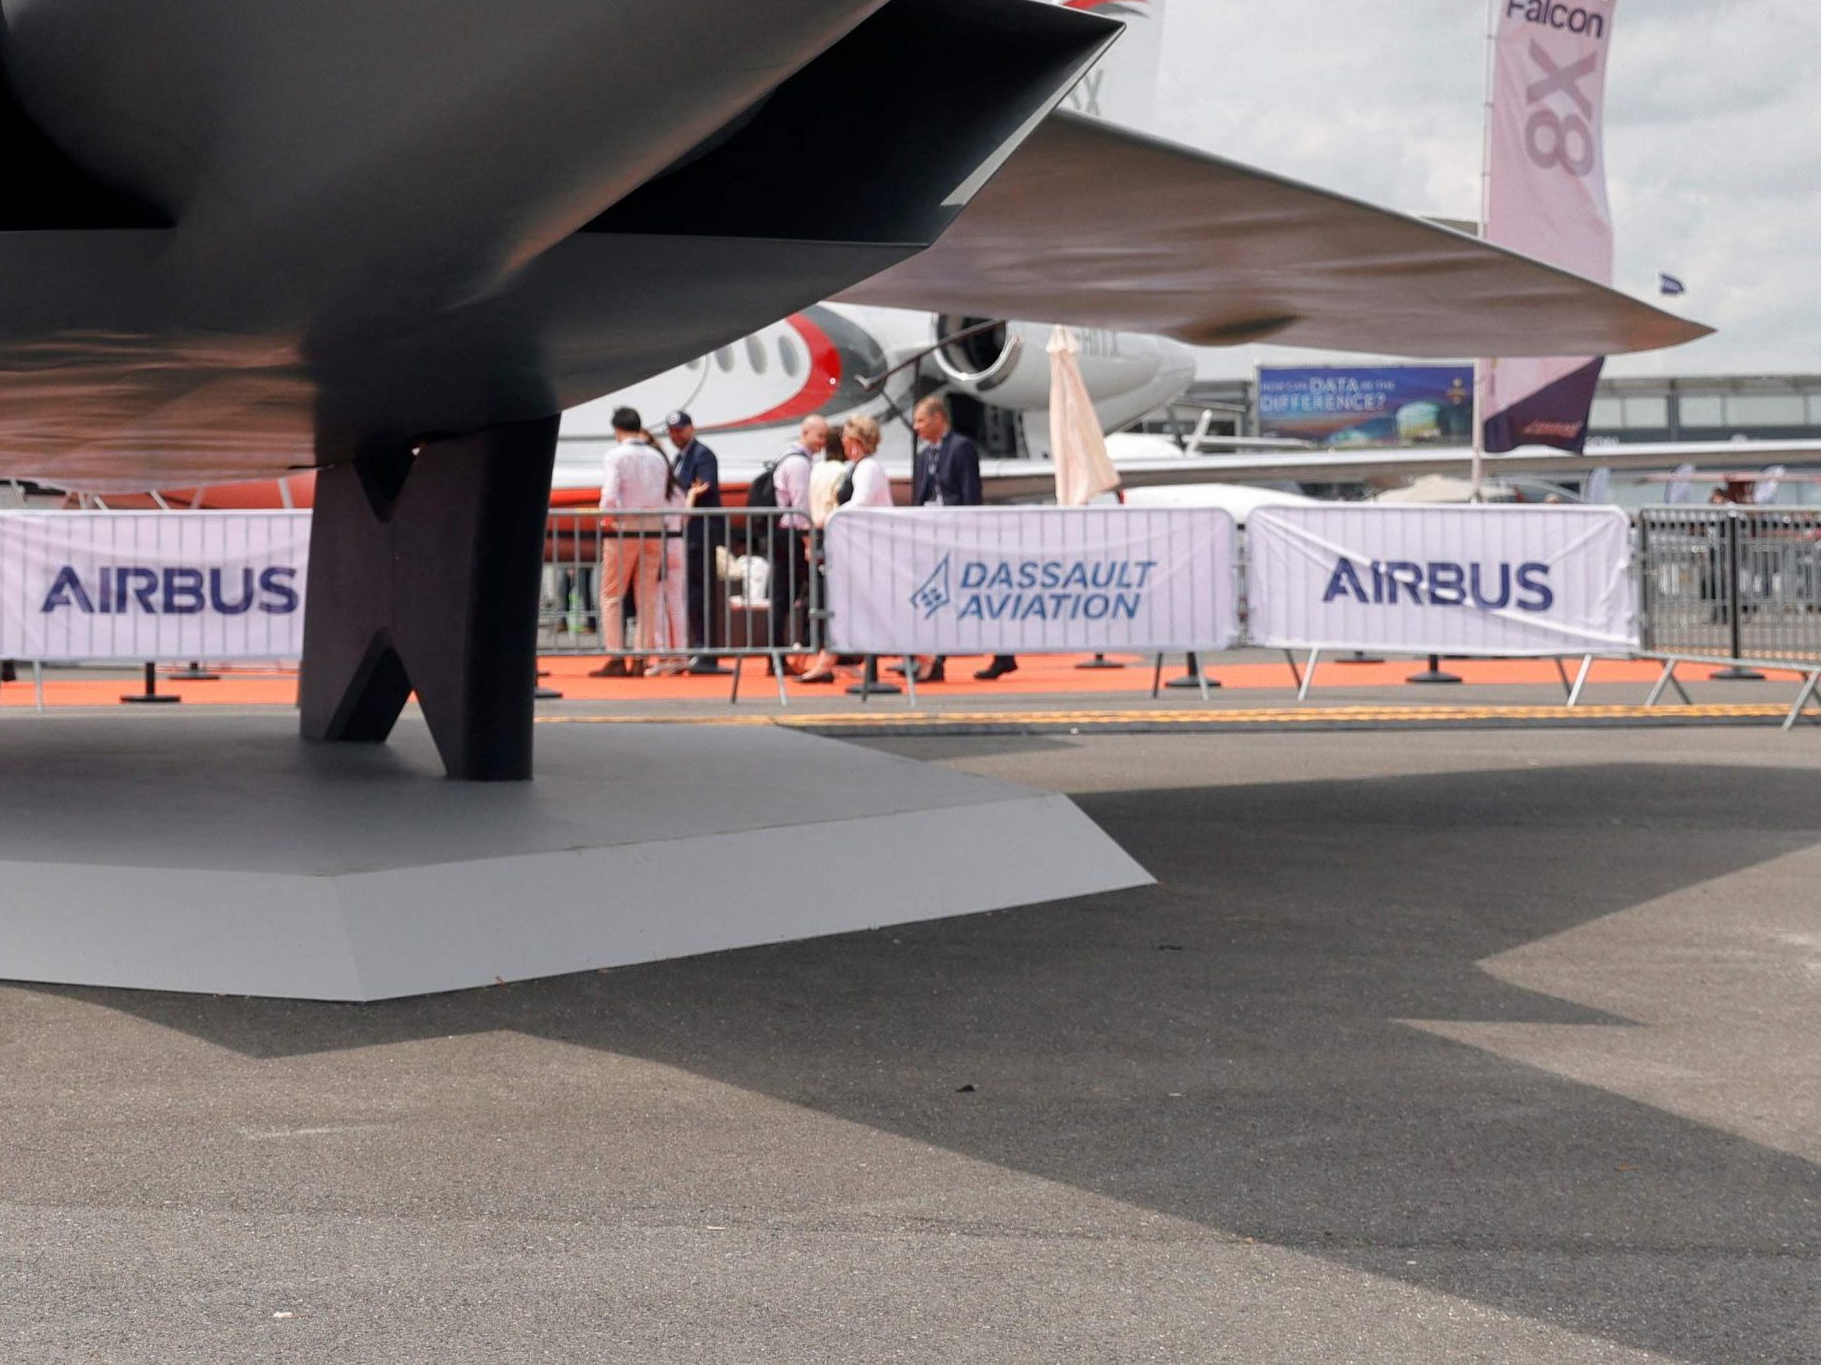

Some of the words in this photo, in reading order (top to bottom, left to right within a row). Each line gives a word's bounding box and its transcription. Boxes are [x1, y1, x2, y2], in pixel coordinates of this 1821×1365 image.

[1309, 377, 1360, 394] DATA
[1260, 393, 1386, 411] DIFFERENCE?
[960, 562, 1157, 589] DASSAULT
[1323, 557, 1554, 612] AIRBUS
[40, 566, 299, 614] AIRBUS
[957, 594, 1141, 620] AVIATION
